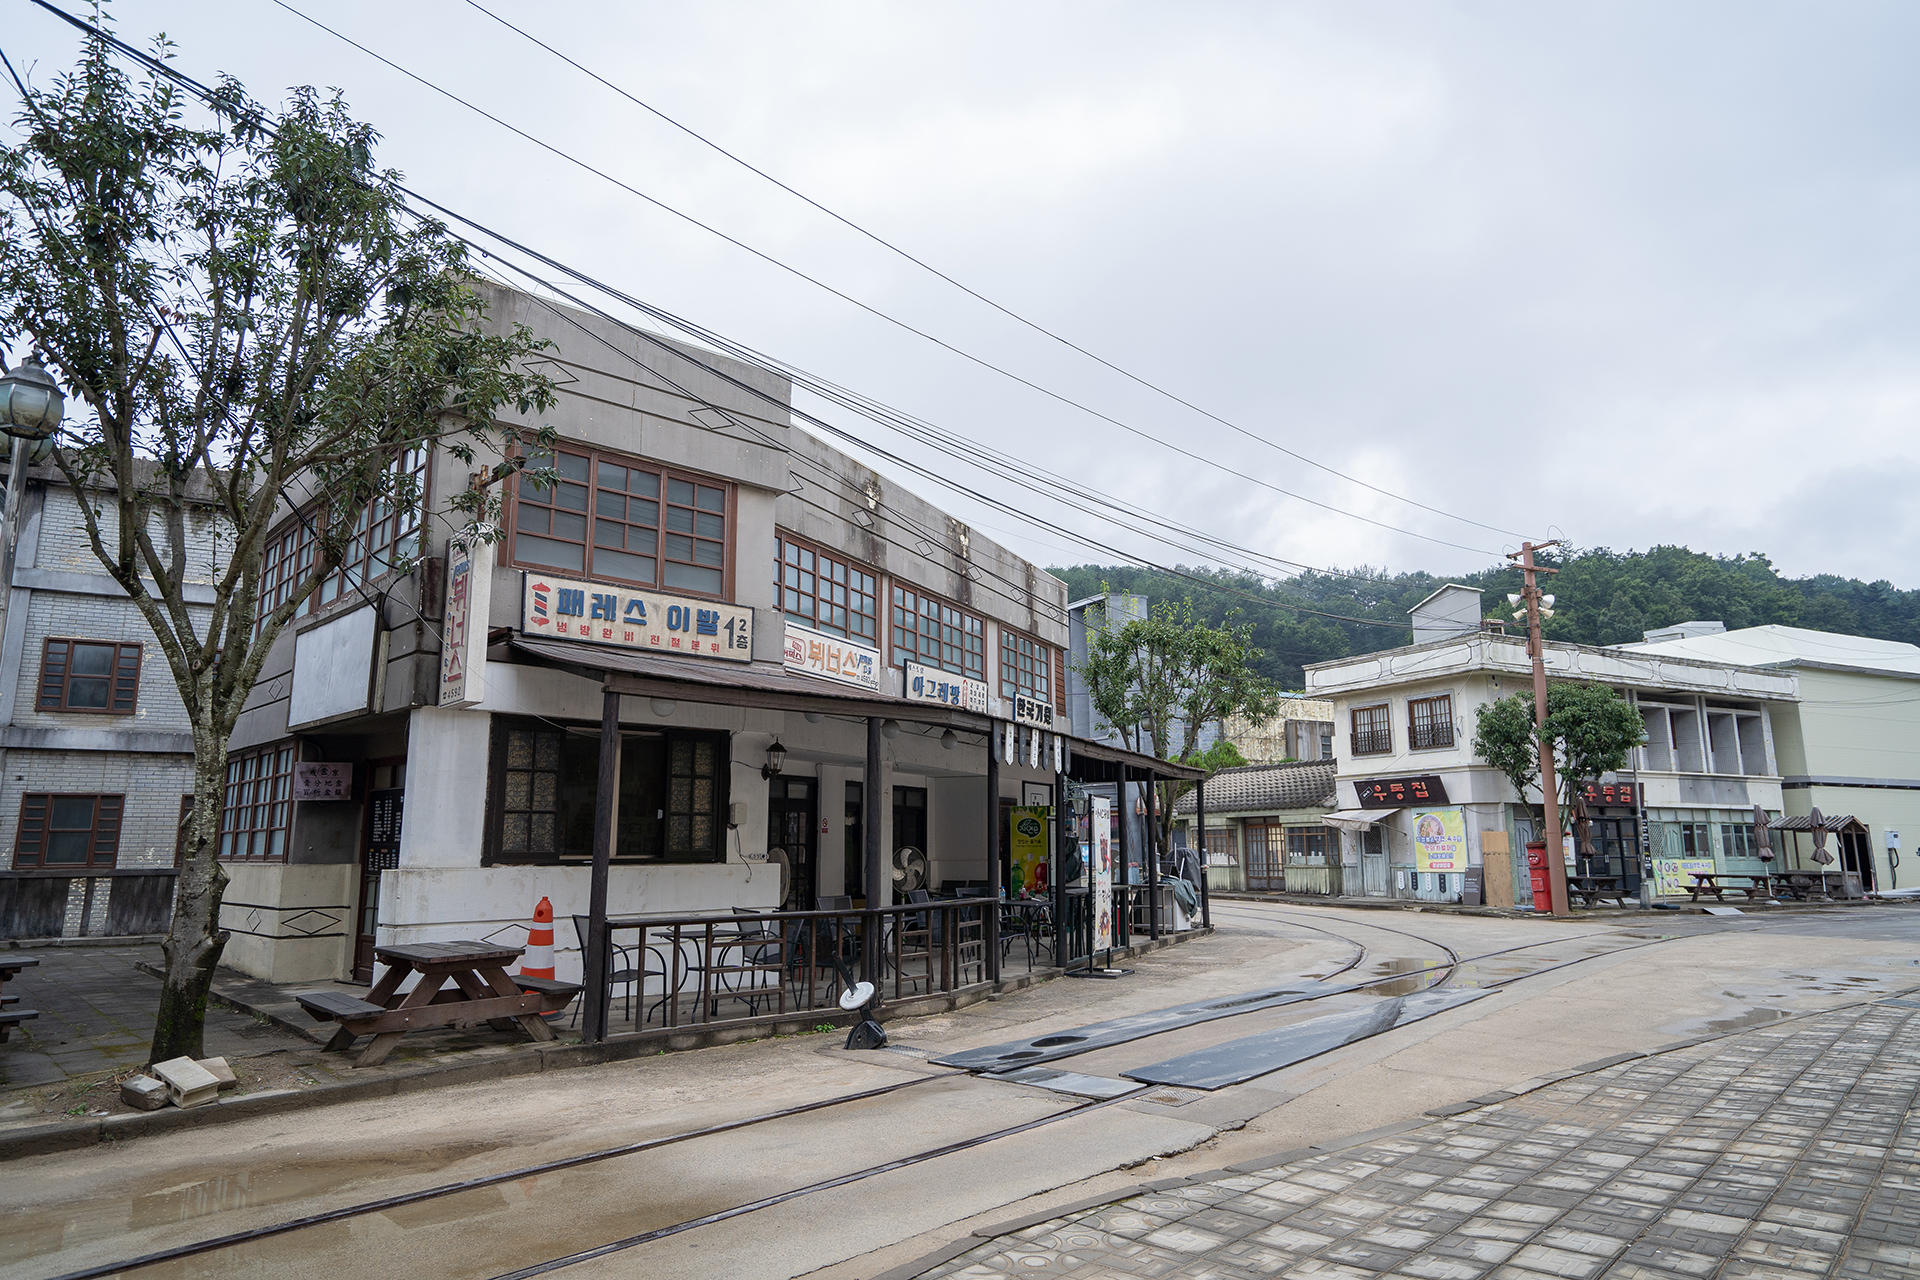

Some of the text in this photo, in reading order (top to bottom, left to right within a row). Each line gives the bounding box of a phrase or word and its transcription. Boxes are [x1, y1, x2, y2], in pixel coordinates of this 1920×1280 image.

[556, 588, 720, 636] 패레스 이발
[448, 573, 469, 682] 뷔너스
[556, 622, 634, 642] 냉방완비
[808, 640, 857, 676] 뷔너스
[1017, 697, 1052, 725] 한국기원
[1373, 782, 1429, 801] 우동집
[1585, 785, 1631, 803] 우동집
